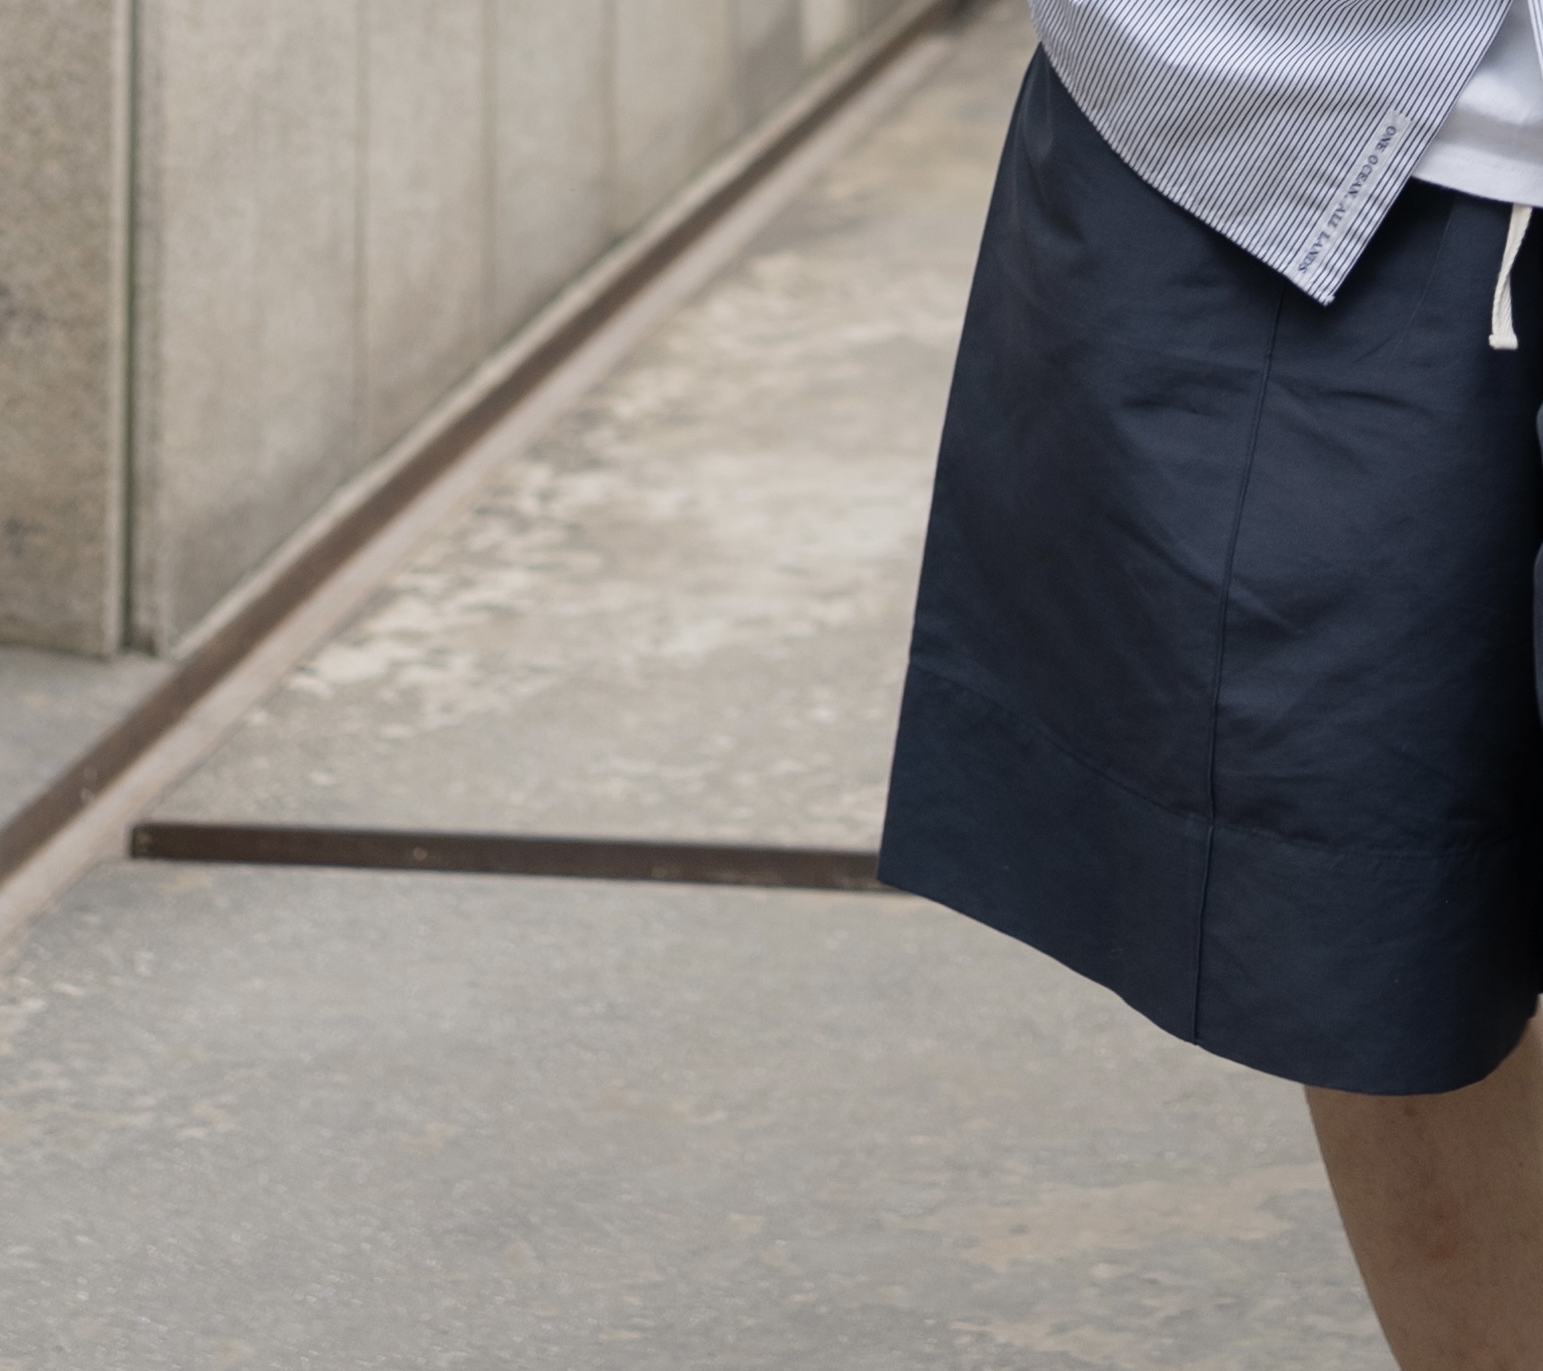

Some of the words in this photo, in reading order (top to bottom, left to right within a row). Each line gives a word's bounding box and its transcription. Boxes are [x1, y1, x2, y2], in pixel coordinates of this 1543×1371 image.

[1375, 125, 1397, 154] ONE
[1328, 202, 1347, 231] ALL
[1298, 231, 1330, 274] LANDS
